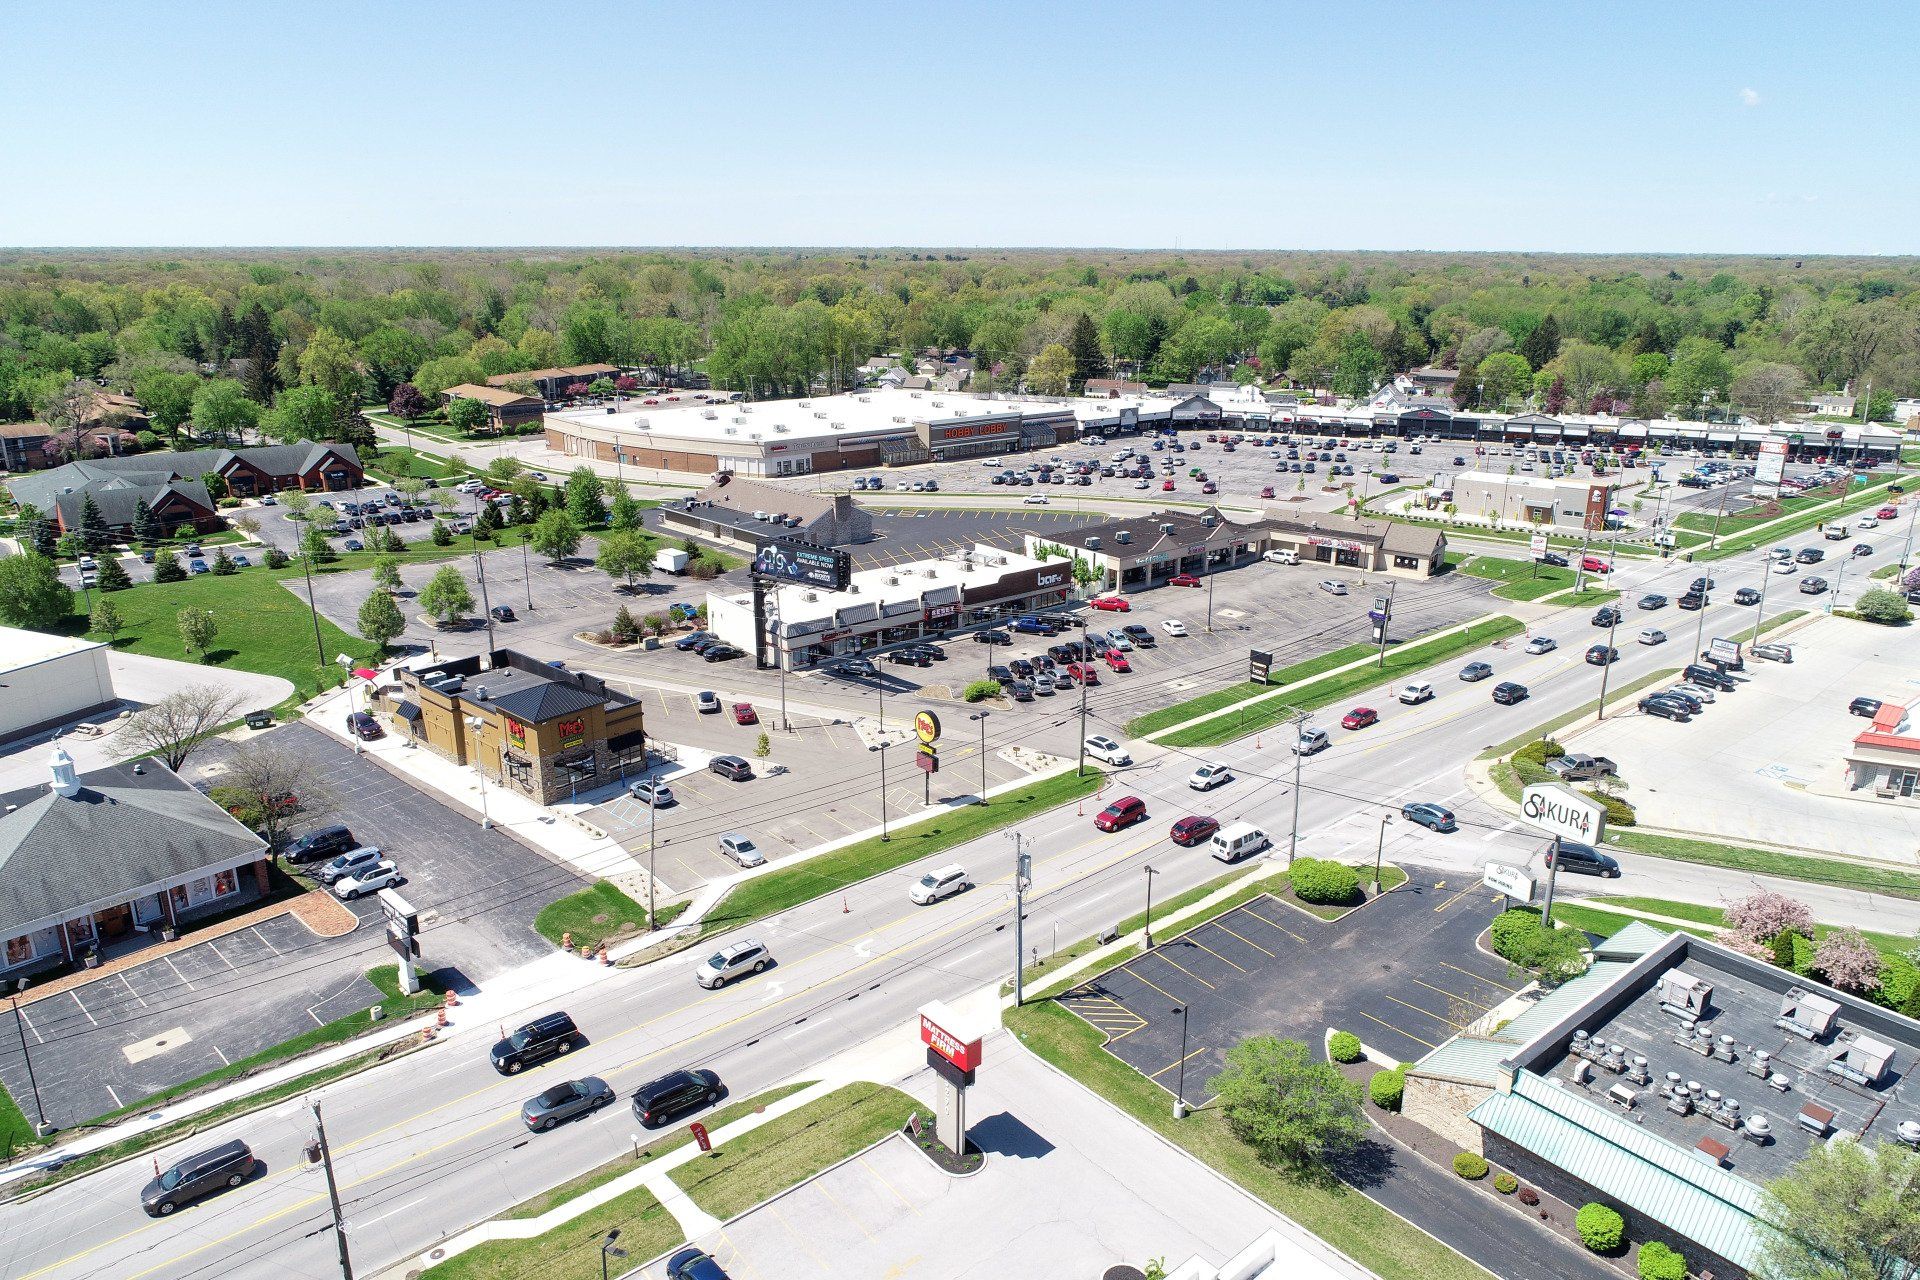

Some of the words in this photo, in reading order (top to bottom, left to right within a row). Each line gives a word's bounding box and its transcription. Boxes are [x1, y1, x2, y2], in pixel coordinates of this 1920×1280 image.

[944, 427, 975, 438] HOBBY
[978, 422, 1008, 434] LOBBY
[796, 551, 818, 561] EXTREME
[796, 558, 820, 567] AVAILABLE
[1523, 793, 1590, 837] SAKURA
[922, 1017, 965, 1055] MATTRESS
[930, 1033, 955, 1058] FIRM
